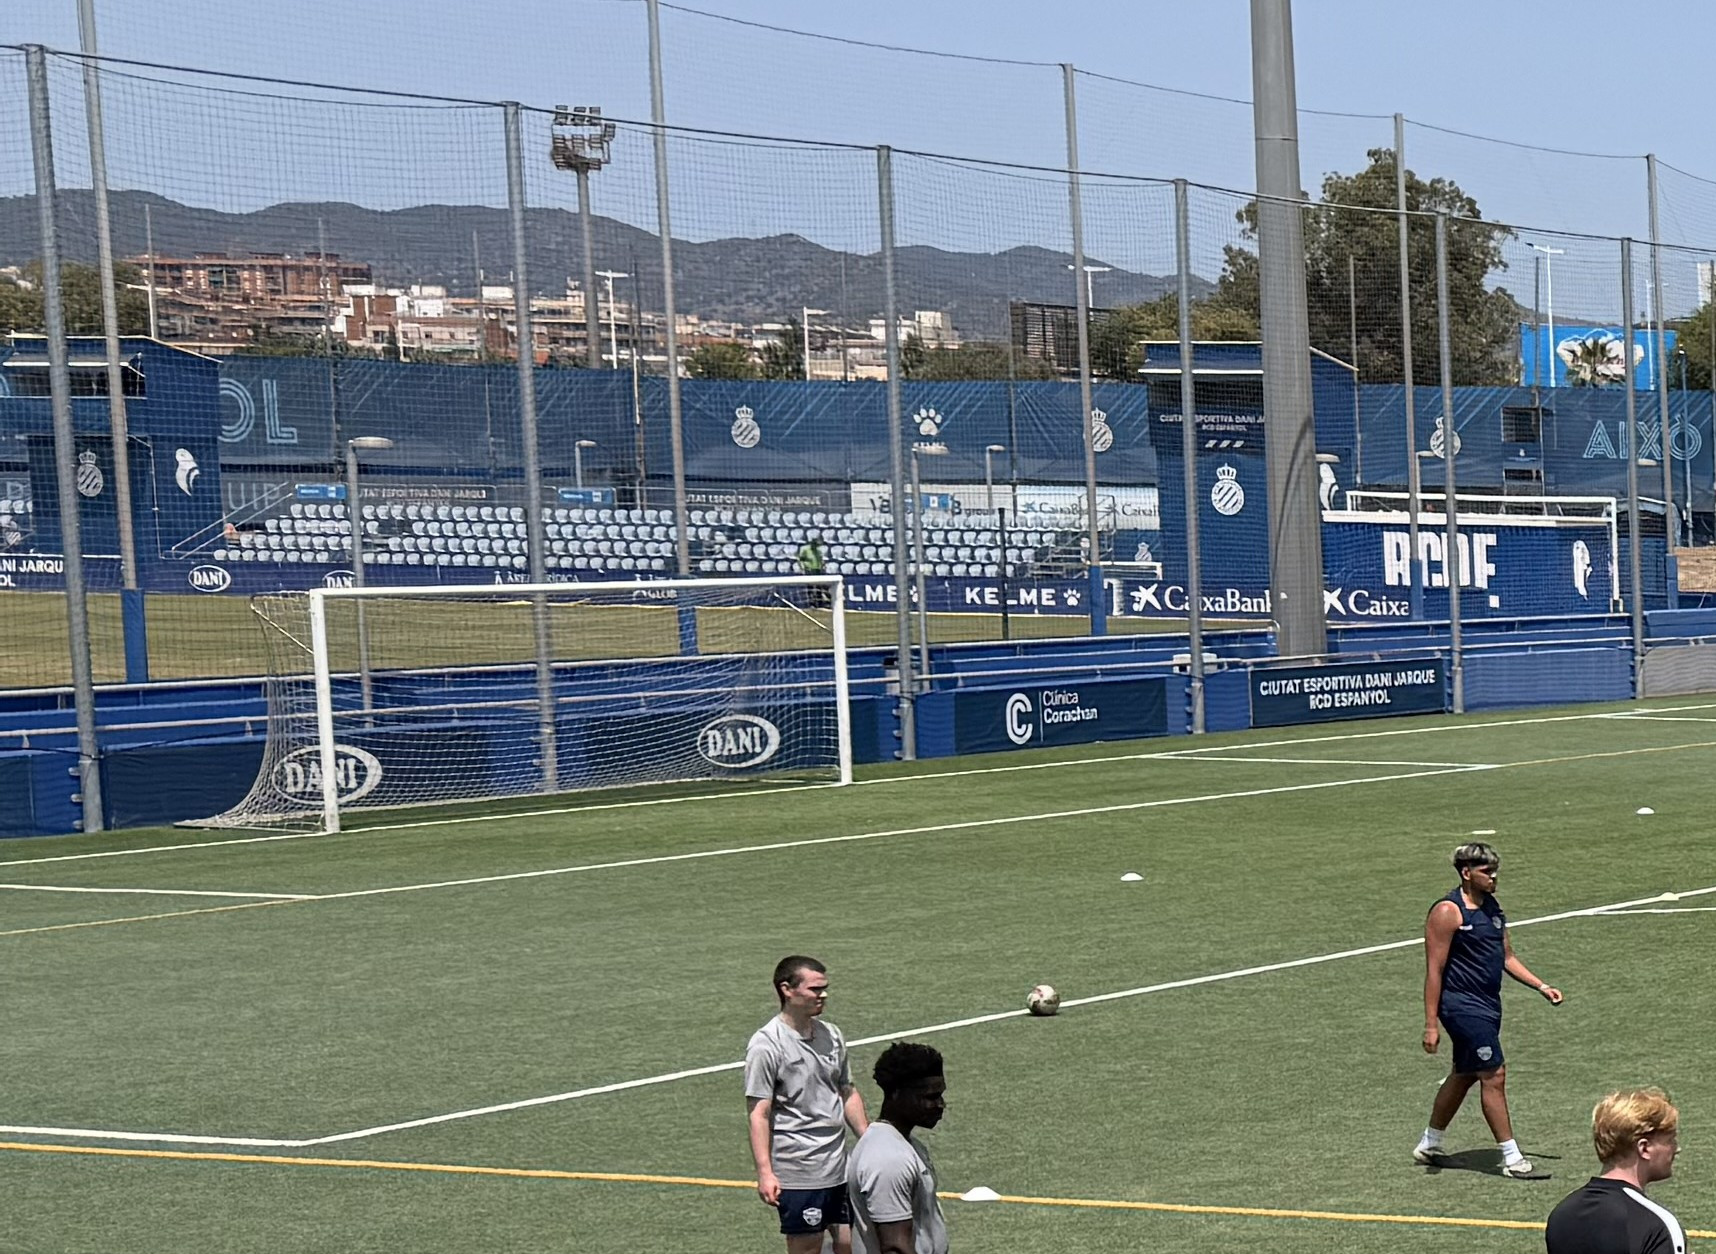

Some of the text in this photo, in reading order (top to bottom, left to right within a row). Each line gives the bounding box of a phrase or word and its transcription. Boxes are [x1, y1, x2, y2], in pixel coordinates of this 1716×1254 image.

[19, 560, 64, 573] JARQU
[192, 569, 223, 586] DANI
[326, 575, 354, 588] DAN
[849, 585, 898, 602] LME
[1260, 669, 1436, 697] CIUTAT ESPORTIVA DANI JARQUE
[1043, 690, 1079, 705] Clínica
[1309, 689, 1392, 710] RCD ESPANYOL
[1043, 706, 1098, 724] Corachan
[706, 726, 764, 757] DANI
